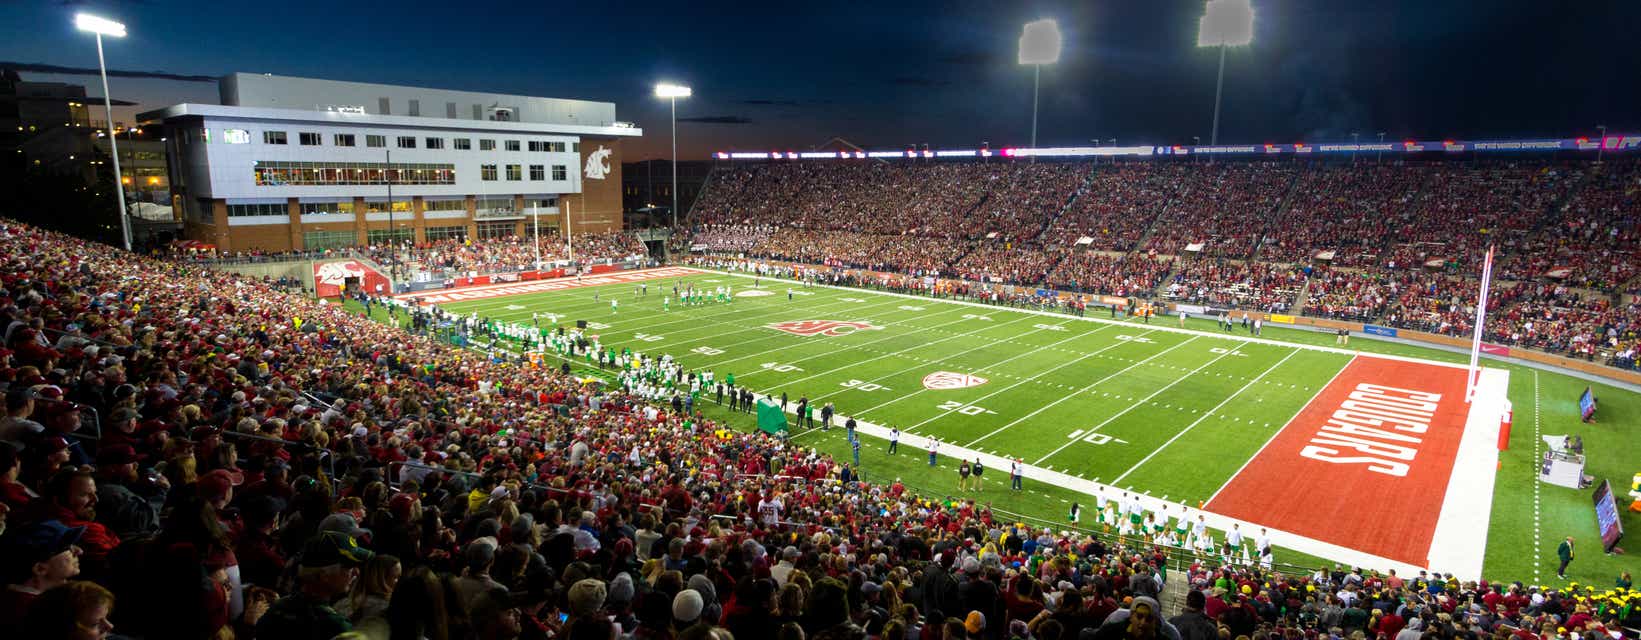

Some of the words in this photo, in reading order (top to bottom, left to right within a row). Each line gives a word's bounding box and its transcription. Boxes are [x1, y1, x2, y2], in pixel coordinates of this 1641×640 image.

[759, 361, 798, 373] 40
[839, 378, 883, 392] 30
[936, 400, 987, 416] 20
[1066, 429, 1113, 445] 10
[1299, 383, 1442, 477] COUGARS
